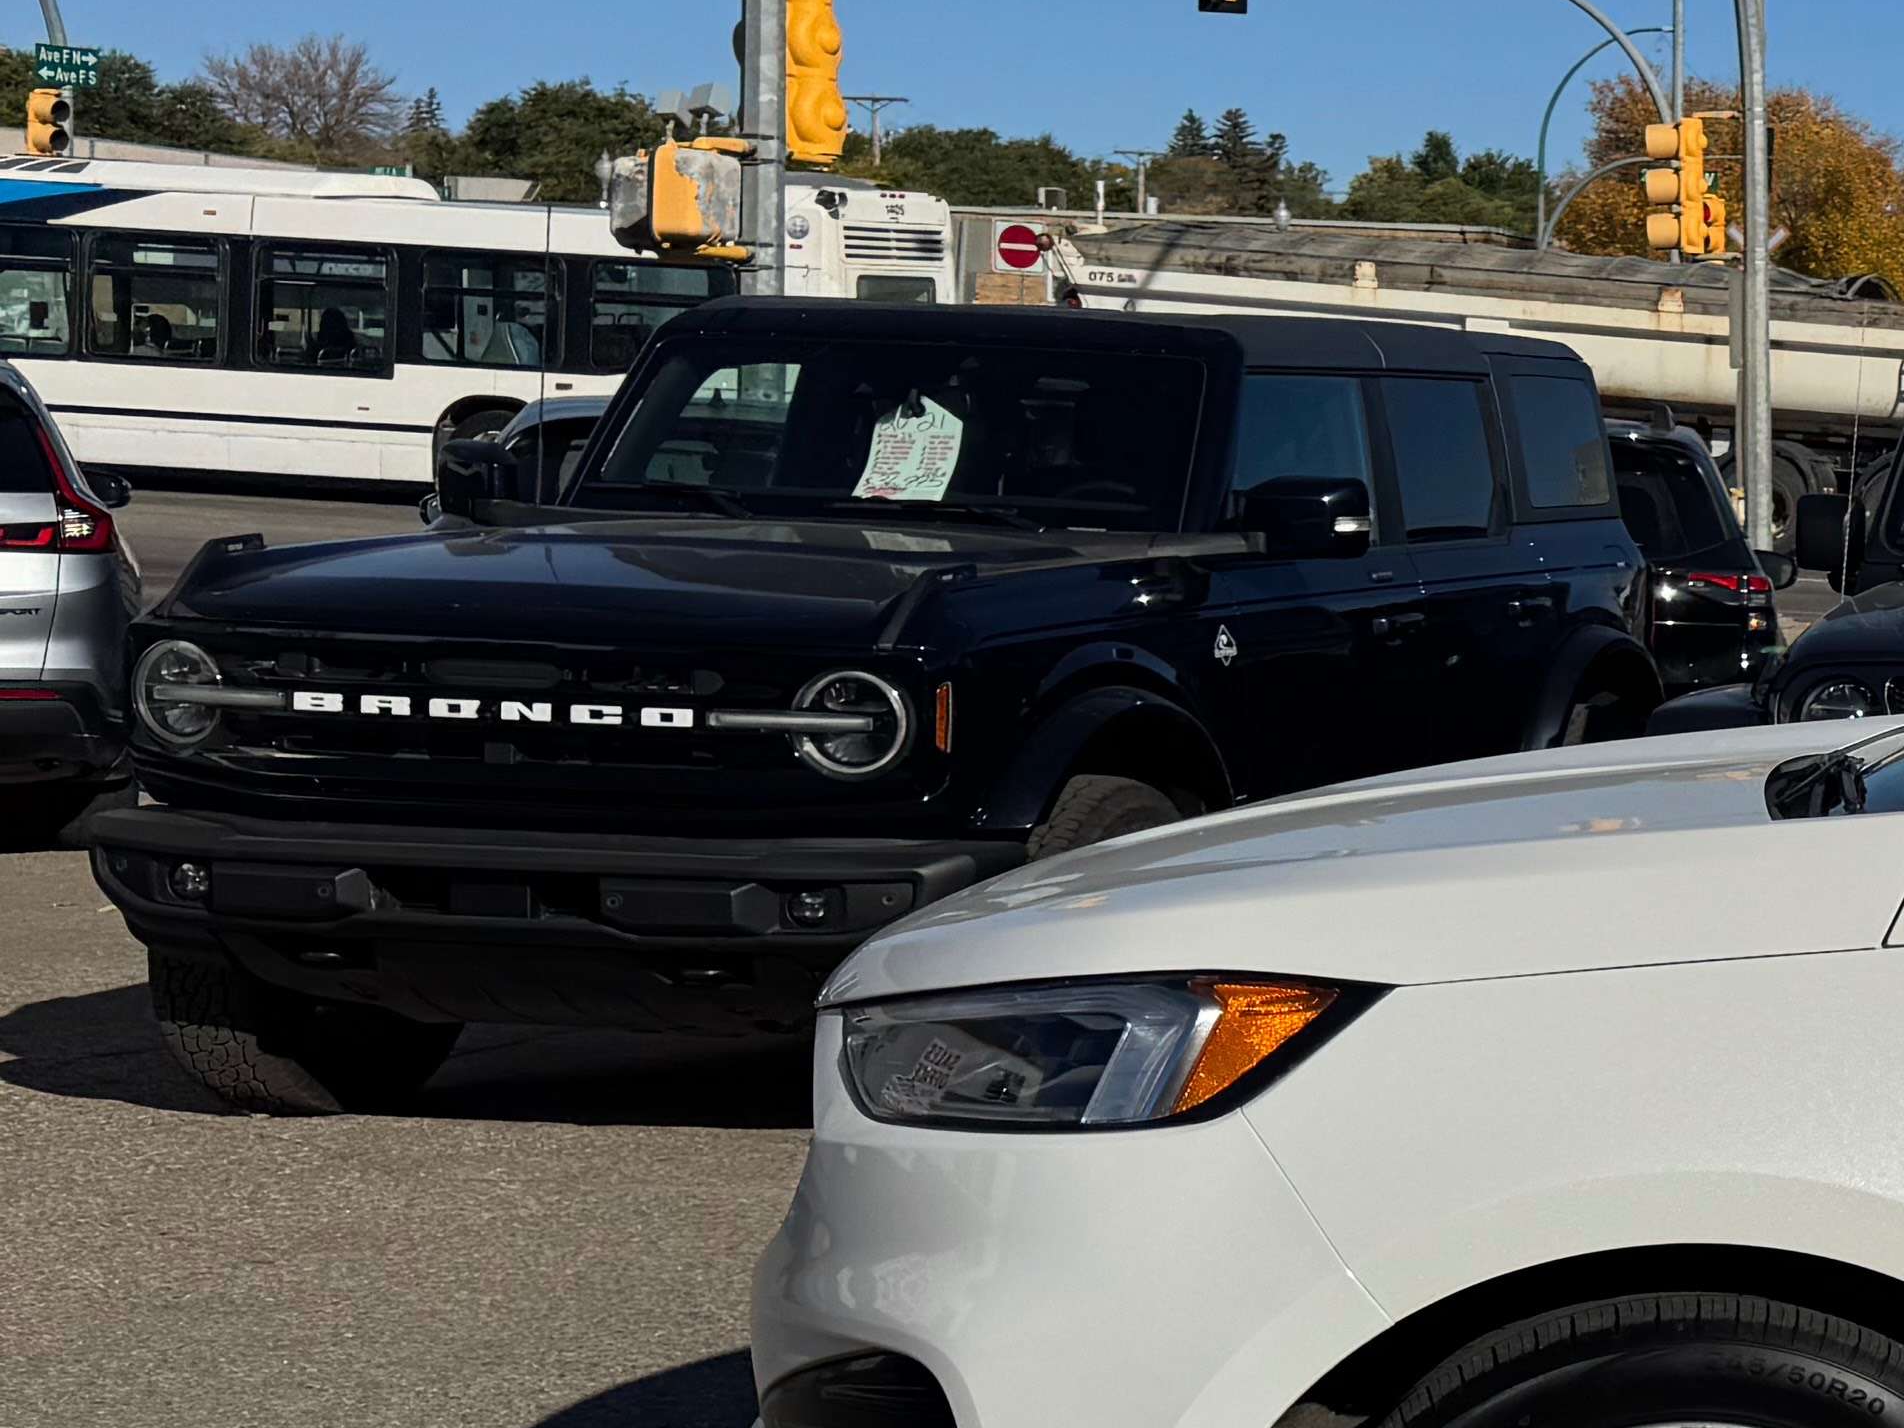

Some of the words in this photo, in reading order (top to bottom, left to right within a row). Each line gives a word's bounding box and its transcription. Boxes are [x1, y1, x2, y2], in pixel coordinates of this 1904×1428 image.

[39, 46, 60, 63] Ave
[62, 49, 71, 65] F
[72, 50, 81, 65] N
[55, 67, 77, 84] Ave
[79, 69, 87, 85] F
[88, 70, 97, 85] S
[292, 690, 694, 728] BRONCO
